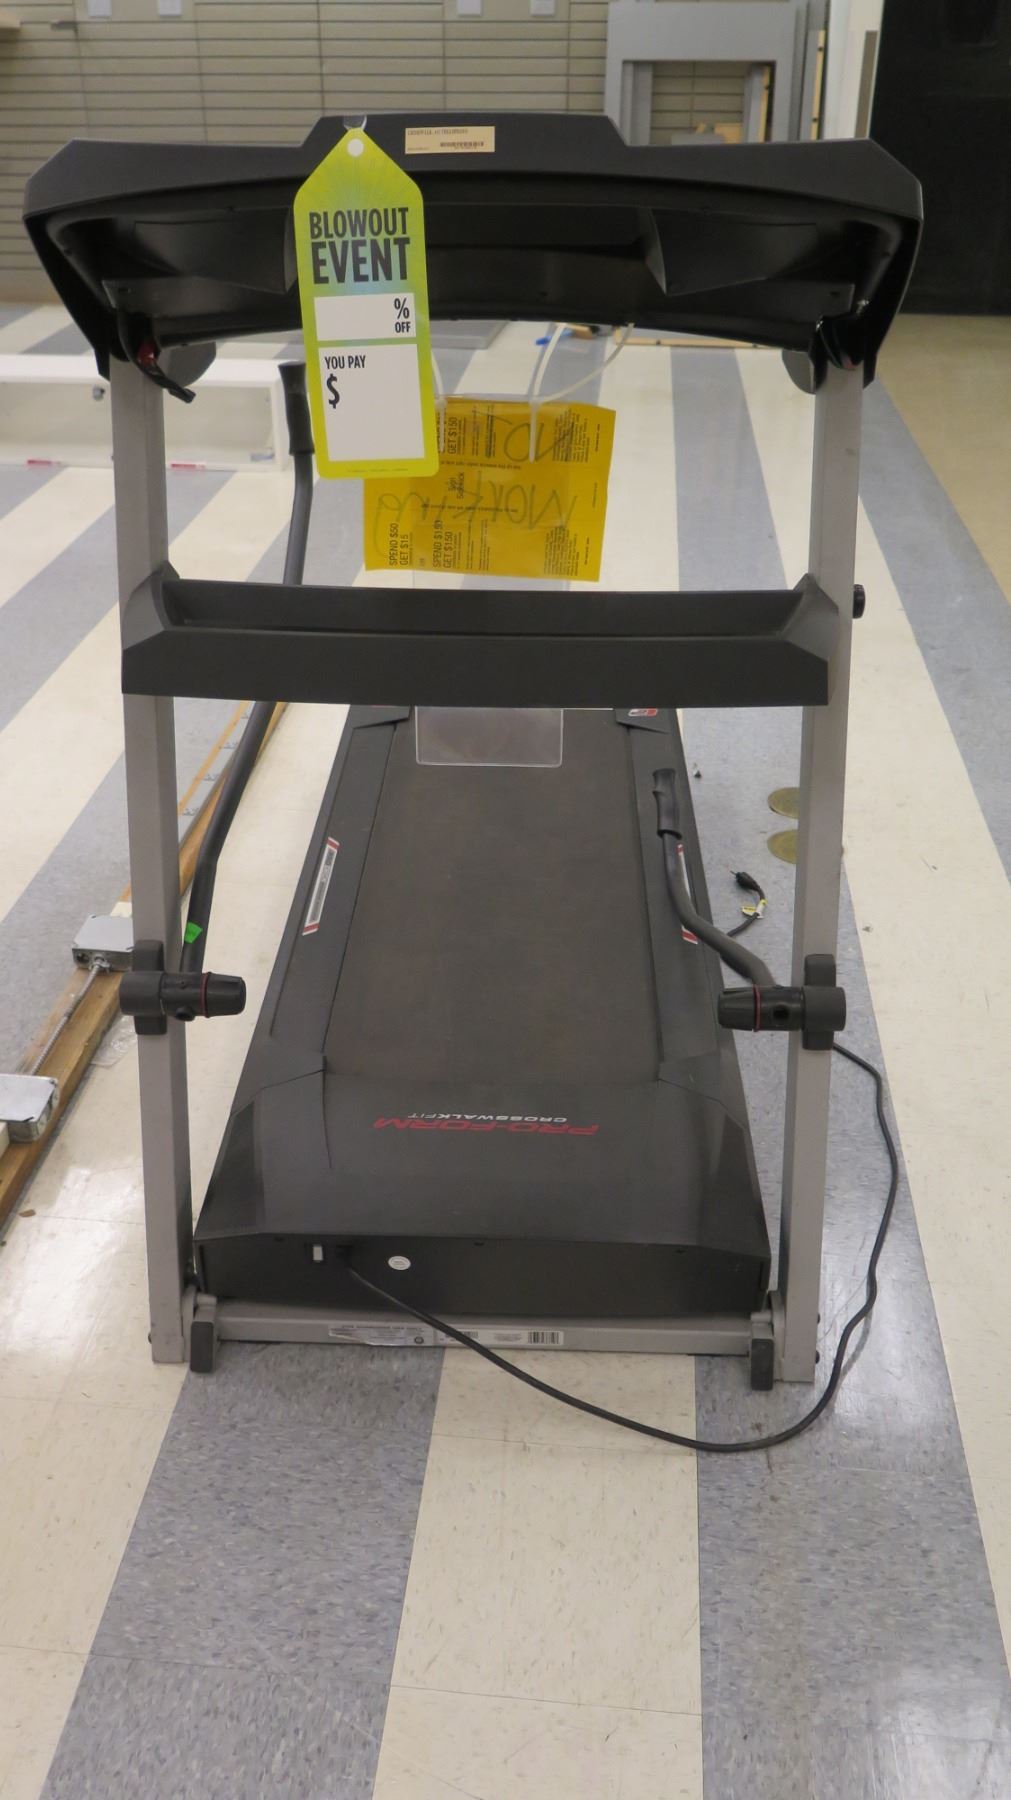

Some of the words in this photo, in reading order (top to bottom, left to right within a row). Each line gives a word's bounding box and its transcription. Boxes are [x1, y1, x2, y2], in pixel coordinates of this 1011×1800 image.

[309, 207, 409, 240] BLOWOUT
[311, 237, 410, 285] EVENT
[394, 298, 410, 319] %
[395, 321, 411, 333] OFF
[325, 356, 345, 370] YOU
[348, 355, 366, 369] PAY
[326, 373, 340, 409] $
[389, 540, 398, 566] SPEND
[400, 548, 409, 566] GET
[433, 543, 442, 568] SPEND
[444, 552, 452, 568] GET
[374, 1115, 599, 1136] PRO-FORM
